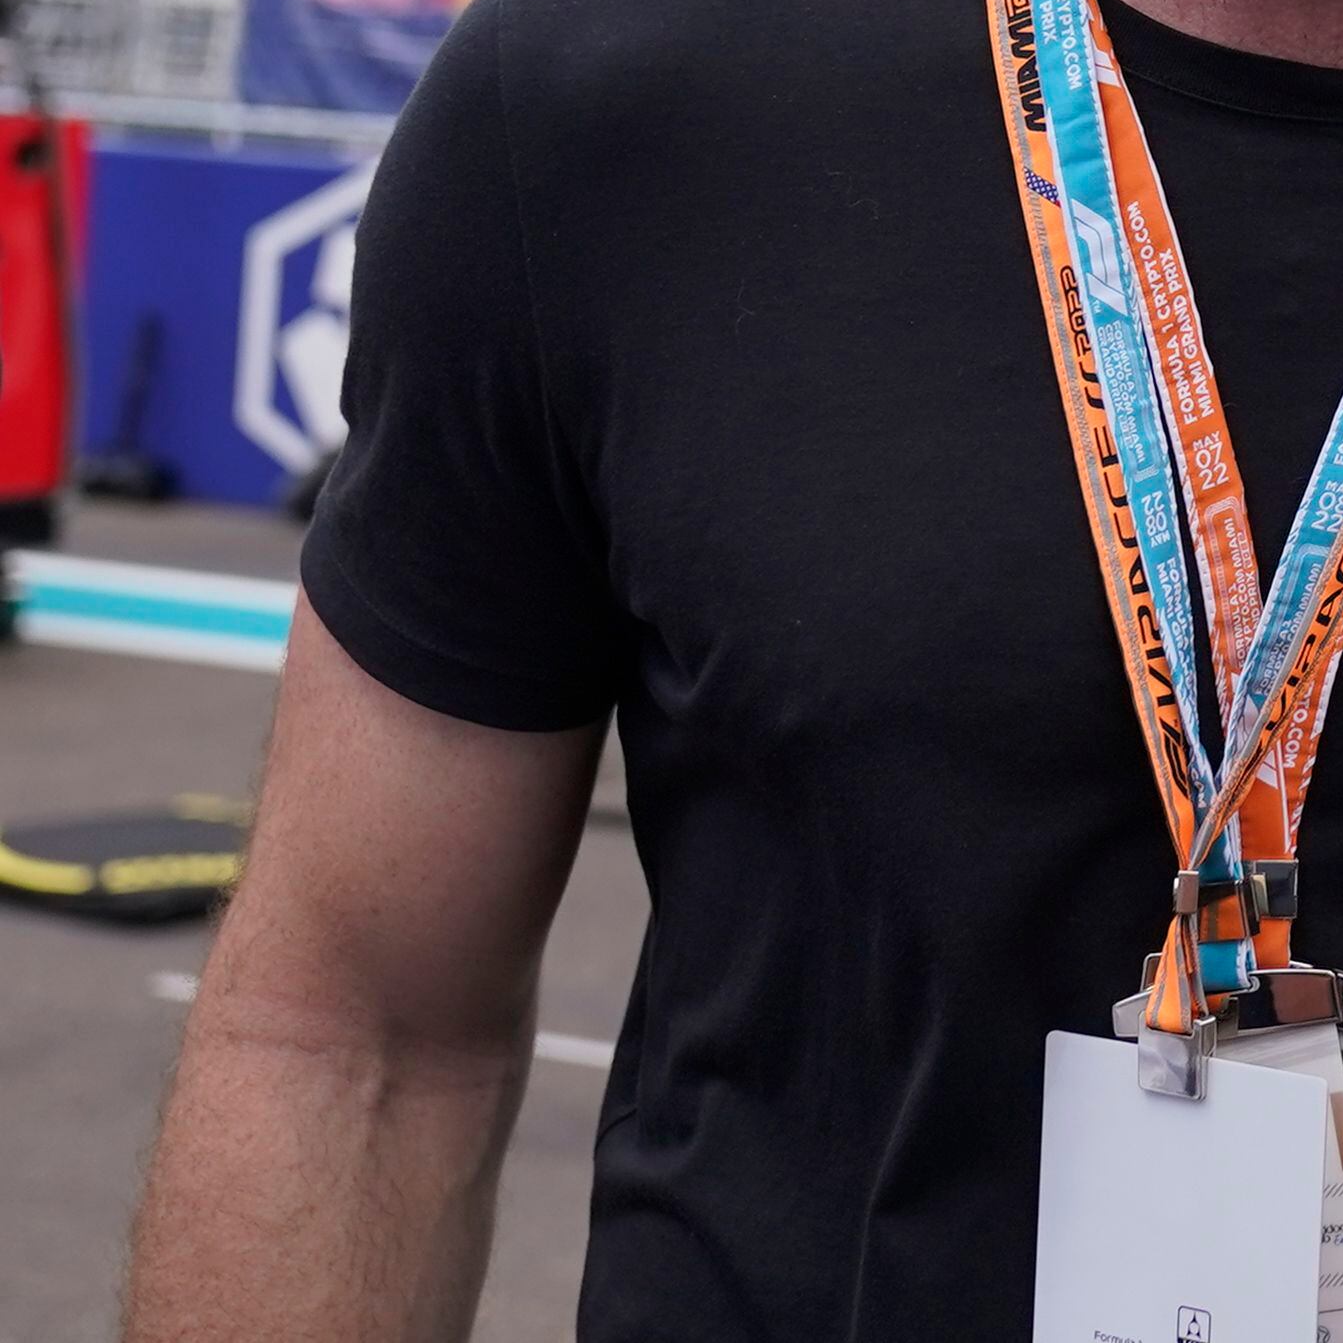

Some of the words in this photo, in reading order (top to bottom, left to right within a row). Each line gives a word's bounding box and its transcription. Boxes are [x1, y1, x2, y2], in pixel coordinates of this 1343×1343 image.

[1040, 4, 1058, 45] PRIX
[1126, 200, 1172, 322] CRYPTO.COM
[1159, 248, 1183, 297] PRIX
[1112, 318, 1136, 392] FORMULA
[1160, 323, 1175, 335] 1
[1172, 294, 1200, 362] GRAND
[1098, 324, 1117, 379] GRAND
[1109, 378, 1123, 413] PRIX
[1104, 323, 1134, 416] CRYPTO.COM
[1126, 417, 1145, 464] MIAMI
[1166, 337, 1199, 426] FORMULA
[1191, 361, 1216, 421] MIAMI
[1192, 430, 1222, 452] MAY
[1195, 442, 1225, 470] 07
[1201, 463, 1230, 491] 22
[1150, 532, 1171, 550] MAY
[1223, 517, 1242, 574] MIAMI
[1311, 510, 1343, 534] 22
[1156, 563, 1175, 619] MIAMI
[1254, 629, 1291, 696] FORMULA
[1283, 680, 1314, 769] TO.COM
